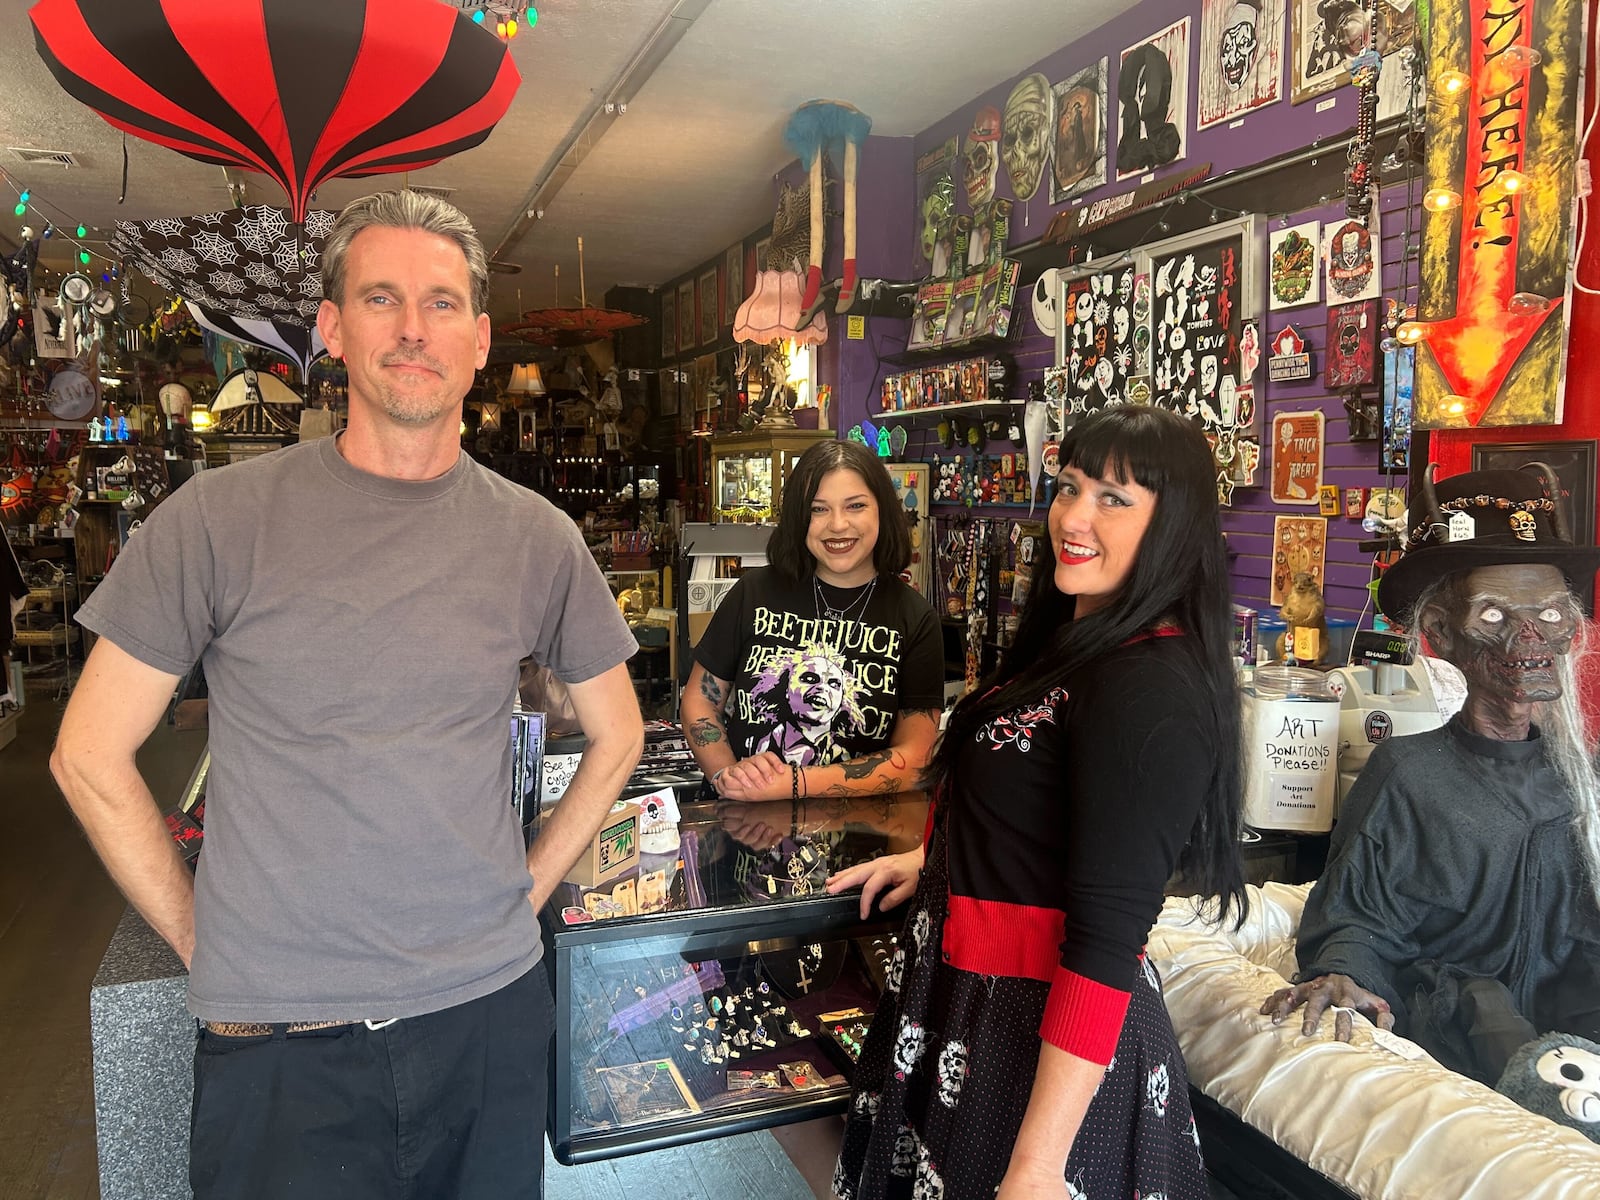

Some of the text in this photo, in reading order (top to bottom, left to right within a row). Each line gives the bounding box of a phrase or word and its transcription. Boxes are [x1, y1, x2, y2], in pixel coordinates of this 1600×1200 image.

[1474, 0, 1527, 250] AY HERE!
[1186, 319, 1214, 330] ZOMBIES
[1294, 437, 1317, 453] TRICK
[1290, 462, 1317, 478] TREAT
[1364, 650, 1391, 660] SHARP
[1275, 715, 1324, 739] ART
[543, 761, 563, 773] See
[1271, 756, 1327, 771] Please!!
[1281, 784, 1313, 793] Support
[1276, 800, 1316, 809] Donations
